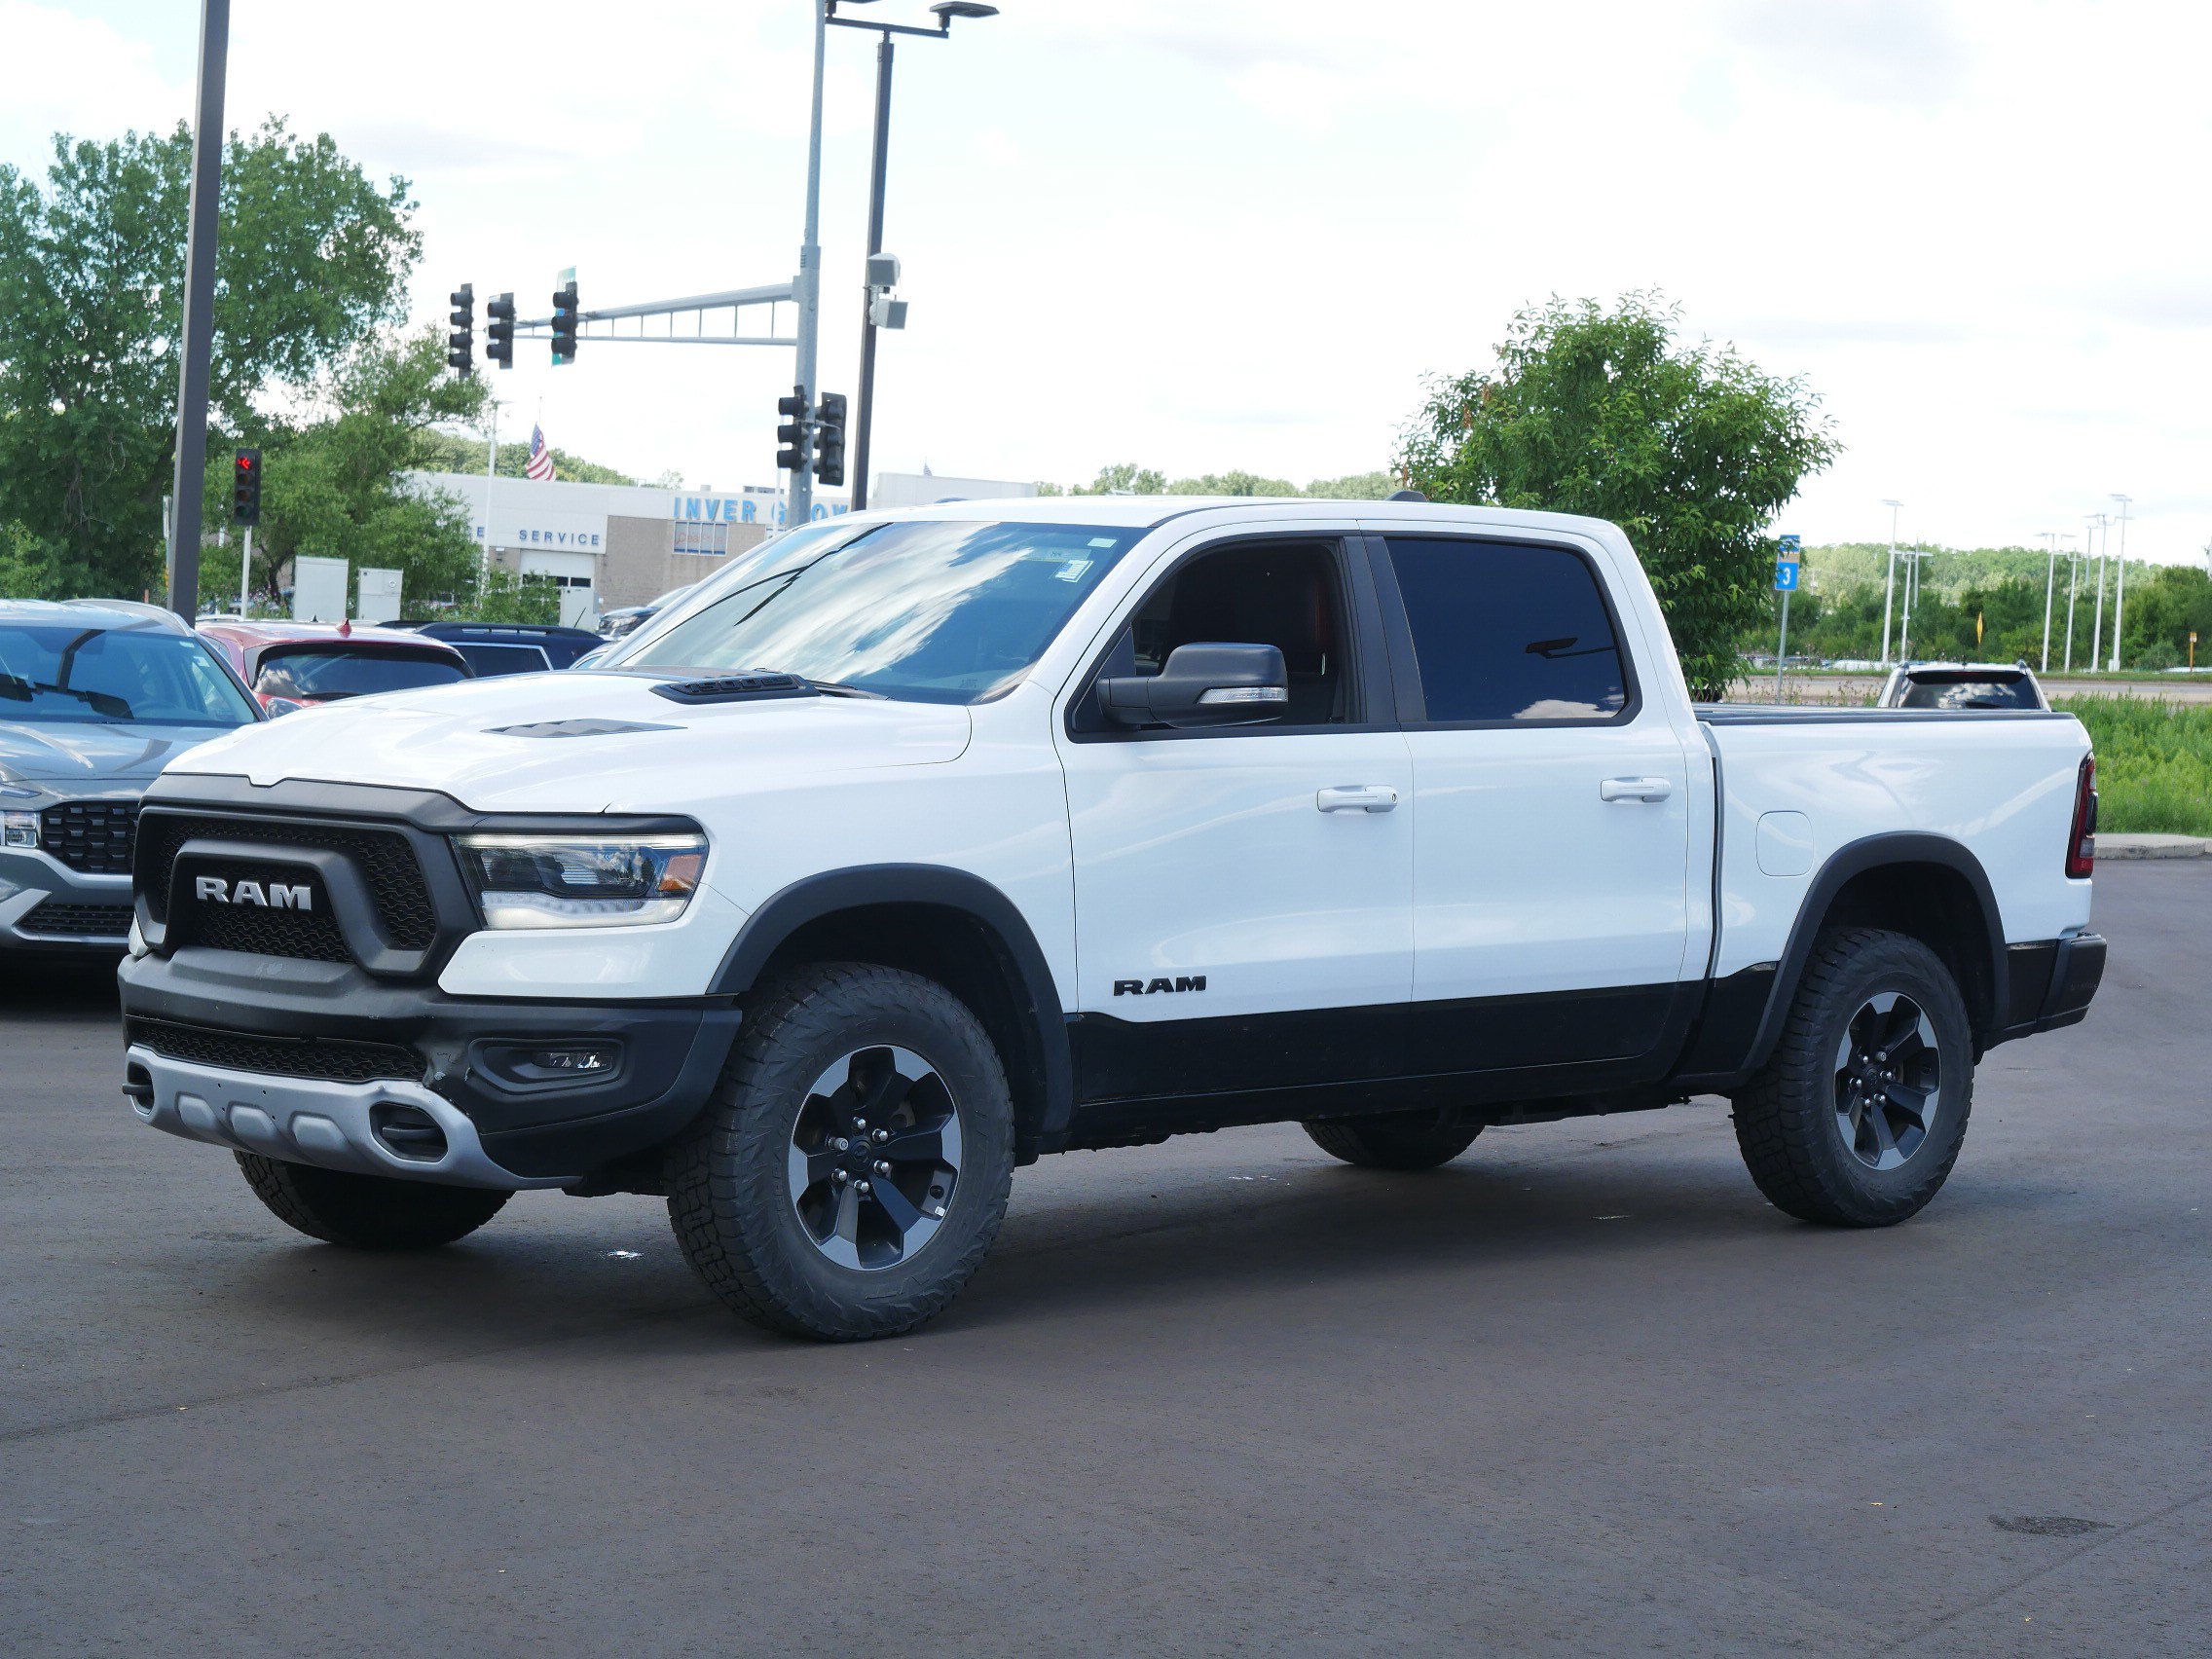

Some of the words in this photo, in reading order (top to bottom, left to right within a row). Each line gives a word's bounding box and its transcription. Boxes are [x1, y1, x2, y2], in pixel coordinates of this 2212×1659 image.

[673, 497, 756, 523] INVER
[519, 530, 600, 546] SERVICE
[1783, 568, 1790, 585] 3
[196, 876, 312, 910] RAM
[1113, 976, 1207, 996] RAM
